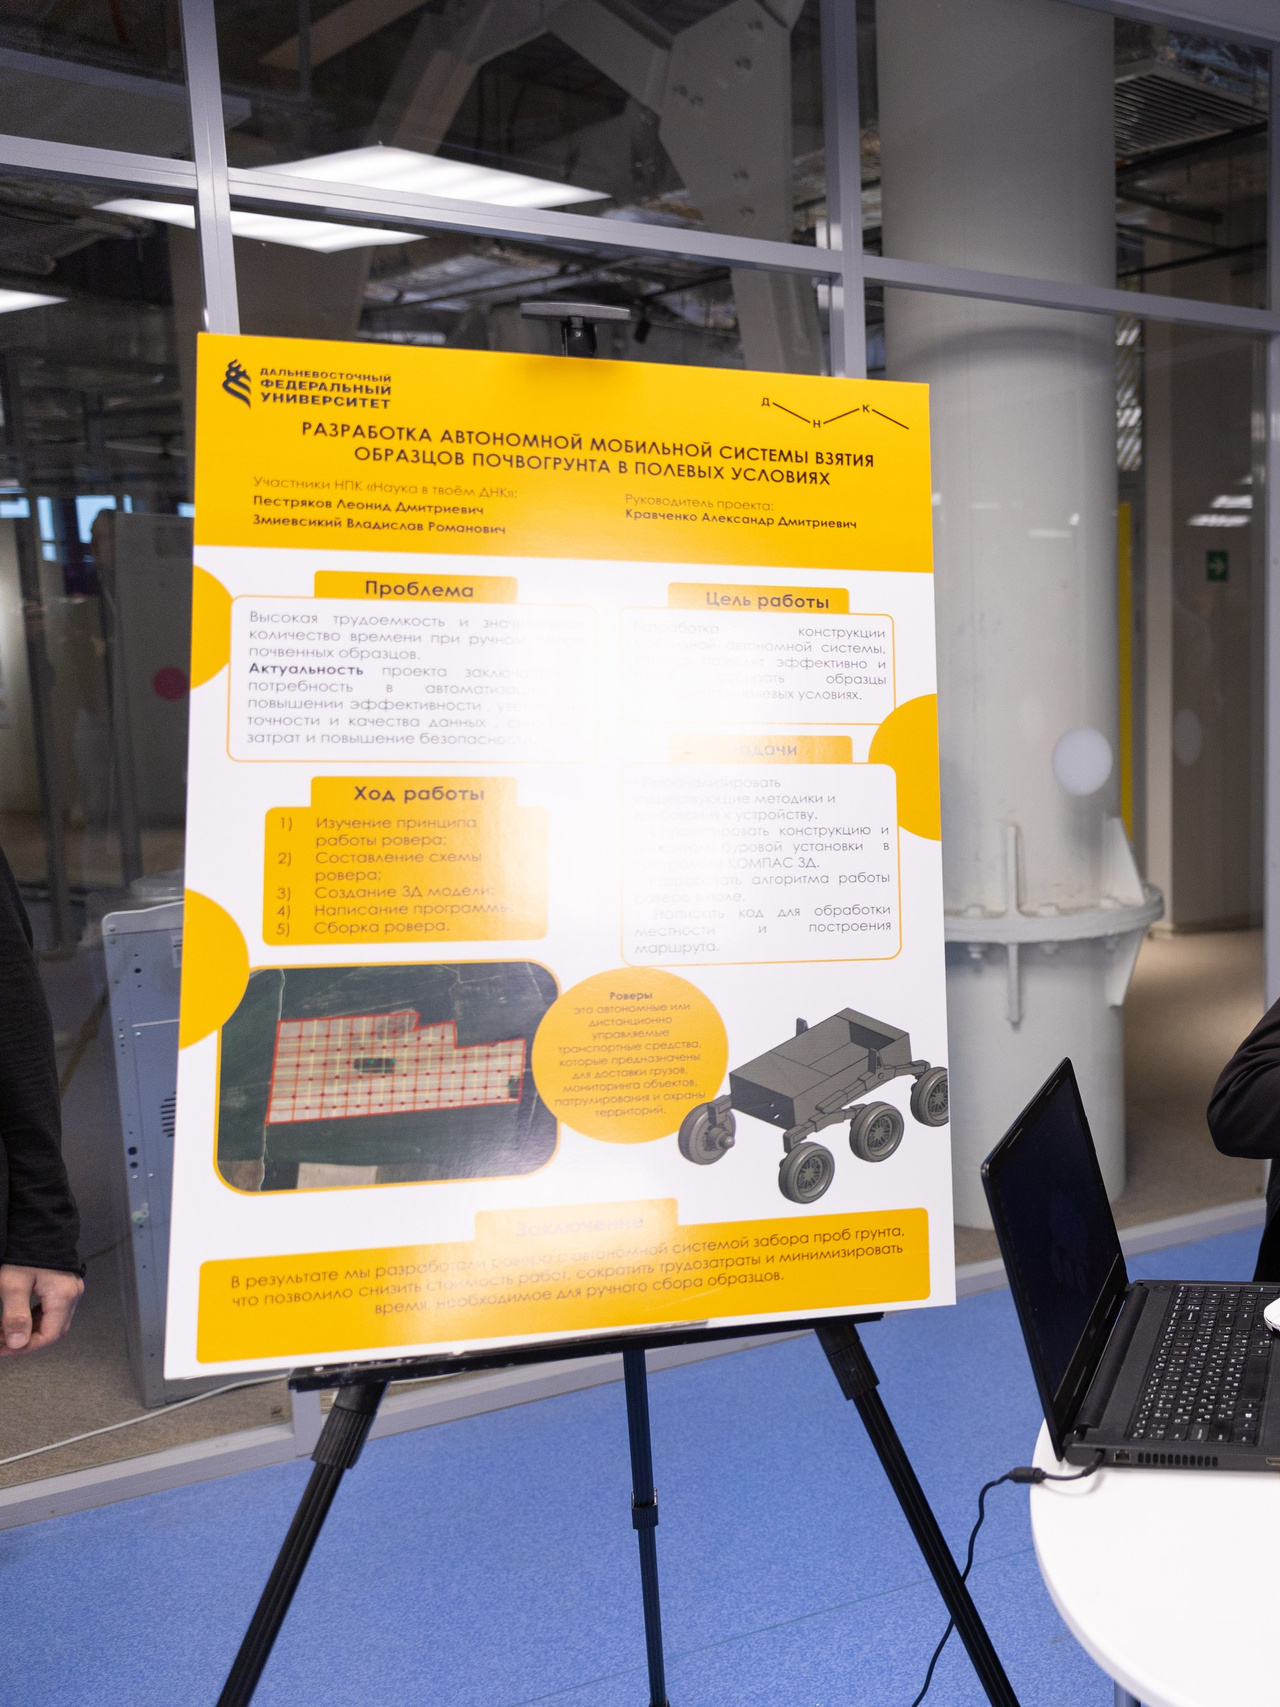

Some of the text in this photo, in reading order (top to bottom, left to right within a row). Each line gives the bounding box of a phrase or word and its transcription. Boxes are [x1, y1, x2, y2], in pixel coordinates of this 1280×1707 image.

[260, 368, 391, 382] ДАЛЬНЕВОСТОЧНЫЙ
[260, 379, 392, 395] ФЕДЕРАЛЬНЫЙ
[261, 392, 390, 409] УНИВЕРСИТЕТ
[762, 397, 770, 407] Д
[862, 404, 870, 413] К
[813, 419, 820, 428] Н
[302, 422, 874, 467] РАЗРАБОТКА АВТОНОМНОЙ МОБИЛЬНОЙ СИСТЕМЫ ВЗЯТИЯ
[354, 447, 830, 486] ОБРАЗЦОВ ПОЧВОГРУНТА В ПОЛЕВЫХ УСЛОВИЯХ
[253, 476, 330, 490] Участники
[335, 479, 362, 490] НПК
[367, 480, 418, 496] «Наука
[432, 483, 475, 497] твоём
[253, 495, 484, 515] Пестряков Леонид Дмитриевич
[625, 494, 774, 514] Руководитель проекта:
[253, 514, 506, 535] Змиевсикий Владислав Романович
[626, 509, 856, 529] Кравченко Александр Дмитриевич
[365, 580, 474, 598] Проблема
[706, 592, 829, 610] Цель работы
[250, 611, 468, 629] Высокая трудоемкость и
[250, 629, 340, 642] количество
[351, 632, 422, 644] времени
[431, 634, 460, 646] при
[799, 626, 885, 639] конструкции
[250, 647, 421, 661] почвенных образцов.
[821, 643, 886, 655] системы,
[776, 656, 867, 670] эффективно
[249, 662, 447, 679] Актуальность проекта
[248, 680, 353, 692] потребность
[826, 674, 886, 686] образцы
[798, 690, 862, 702] условиях.
[248, 698, 481, 713] повышении эффективности
[248, 715, 486, 729] точности и качества данных
[248, 732, 300, 746] затрат
[322, 732, 415, 745] повышение
[354, 786, 484, 803] Ход работы
[755, 793, 836, 804] методики и
[735, 807, 817, 823] устройству.
[280, 817, 476, 831] 1) Изучение принципа
[780, 825, 871, 838] конструкцию
[316, 834, 447, 848] работы ровера;
[722, 839, 782, 855] буровой
[793, 841, 863, 854] установки
[884, 842, 889, 850] в
[278, 852, 482, 866] 2) Составление схемы
[728, 857, 793, 869] КОМПАС
[316, 870, 381, 883] ровера;
[752, 872, 890, 886] алгоритма работы
[277, 888, 290, 902] 3)
[315, 887, 396, 899] Создание
[277, 904, 408, 919] 4) Написание
[738, 908, 764, 918] код
[778, 907, 800, 917] для
[814, 904, 891, 917] обработки
[276, 920, 450, 937] 5) Сборка ровера.
[635, 921, 891, 937] местности и построения
[634, 941, 719, 955] маршрута.
[610, 992, 652, 1002] Роверы
[574, 1003, 690, 1015] это автономные или
[589, 1017, 672, 1028] дистанционно
[593, 1029, 669, 1040] управляемые
[559, 1043, 642, 1055] транспортные
[560, 1054, 700, 1067] которые предназначены
[572, 1069, 646, 1080] для доставки
[563, 1082, 640, 1093] мониторинга
[555, 1091, 705, 1107] патрулирования охраны
[595, 1105, 666, 1118] территорий.
[232, 1275, 240, 1289] В
[246, 1268, 338, 1289] результате
[346, 1268, 370, 1281] мы
[672, 1236, 749, 1255] системой
[753, 1234, 809, 1249] забора
[814, 1229, 851, 1244] проб
[855, 1225, 905, 1241] грунта,
[233, 1296, 258, 1308] что
[264, 1286, 352, 1304] позволило
[359, 1283, 421, 1298] снизить
[577, 1264, 654, 1280] сократить
[658, 1252, 761, 1275] трудозатраты
[766, 1252, 775, 1264] и
[779, 1243, 903, 1264] минимизировать
[557, 1287, 582, 1299] для
[587, 1282, 648, 1298] ручного
[652, 1276, 703, 1292] сбора
[708, 1271, 784, 1288] образцов.
